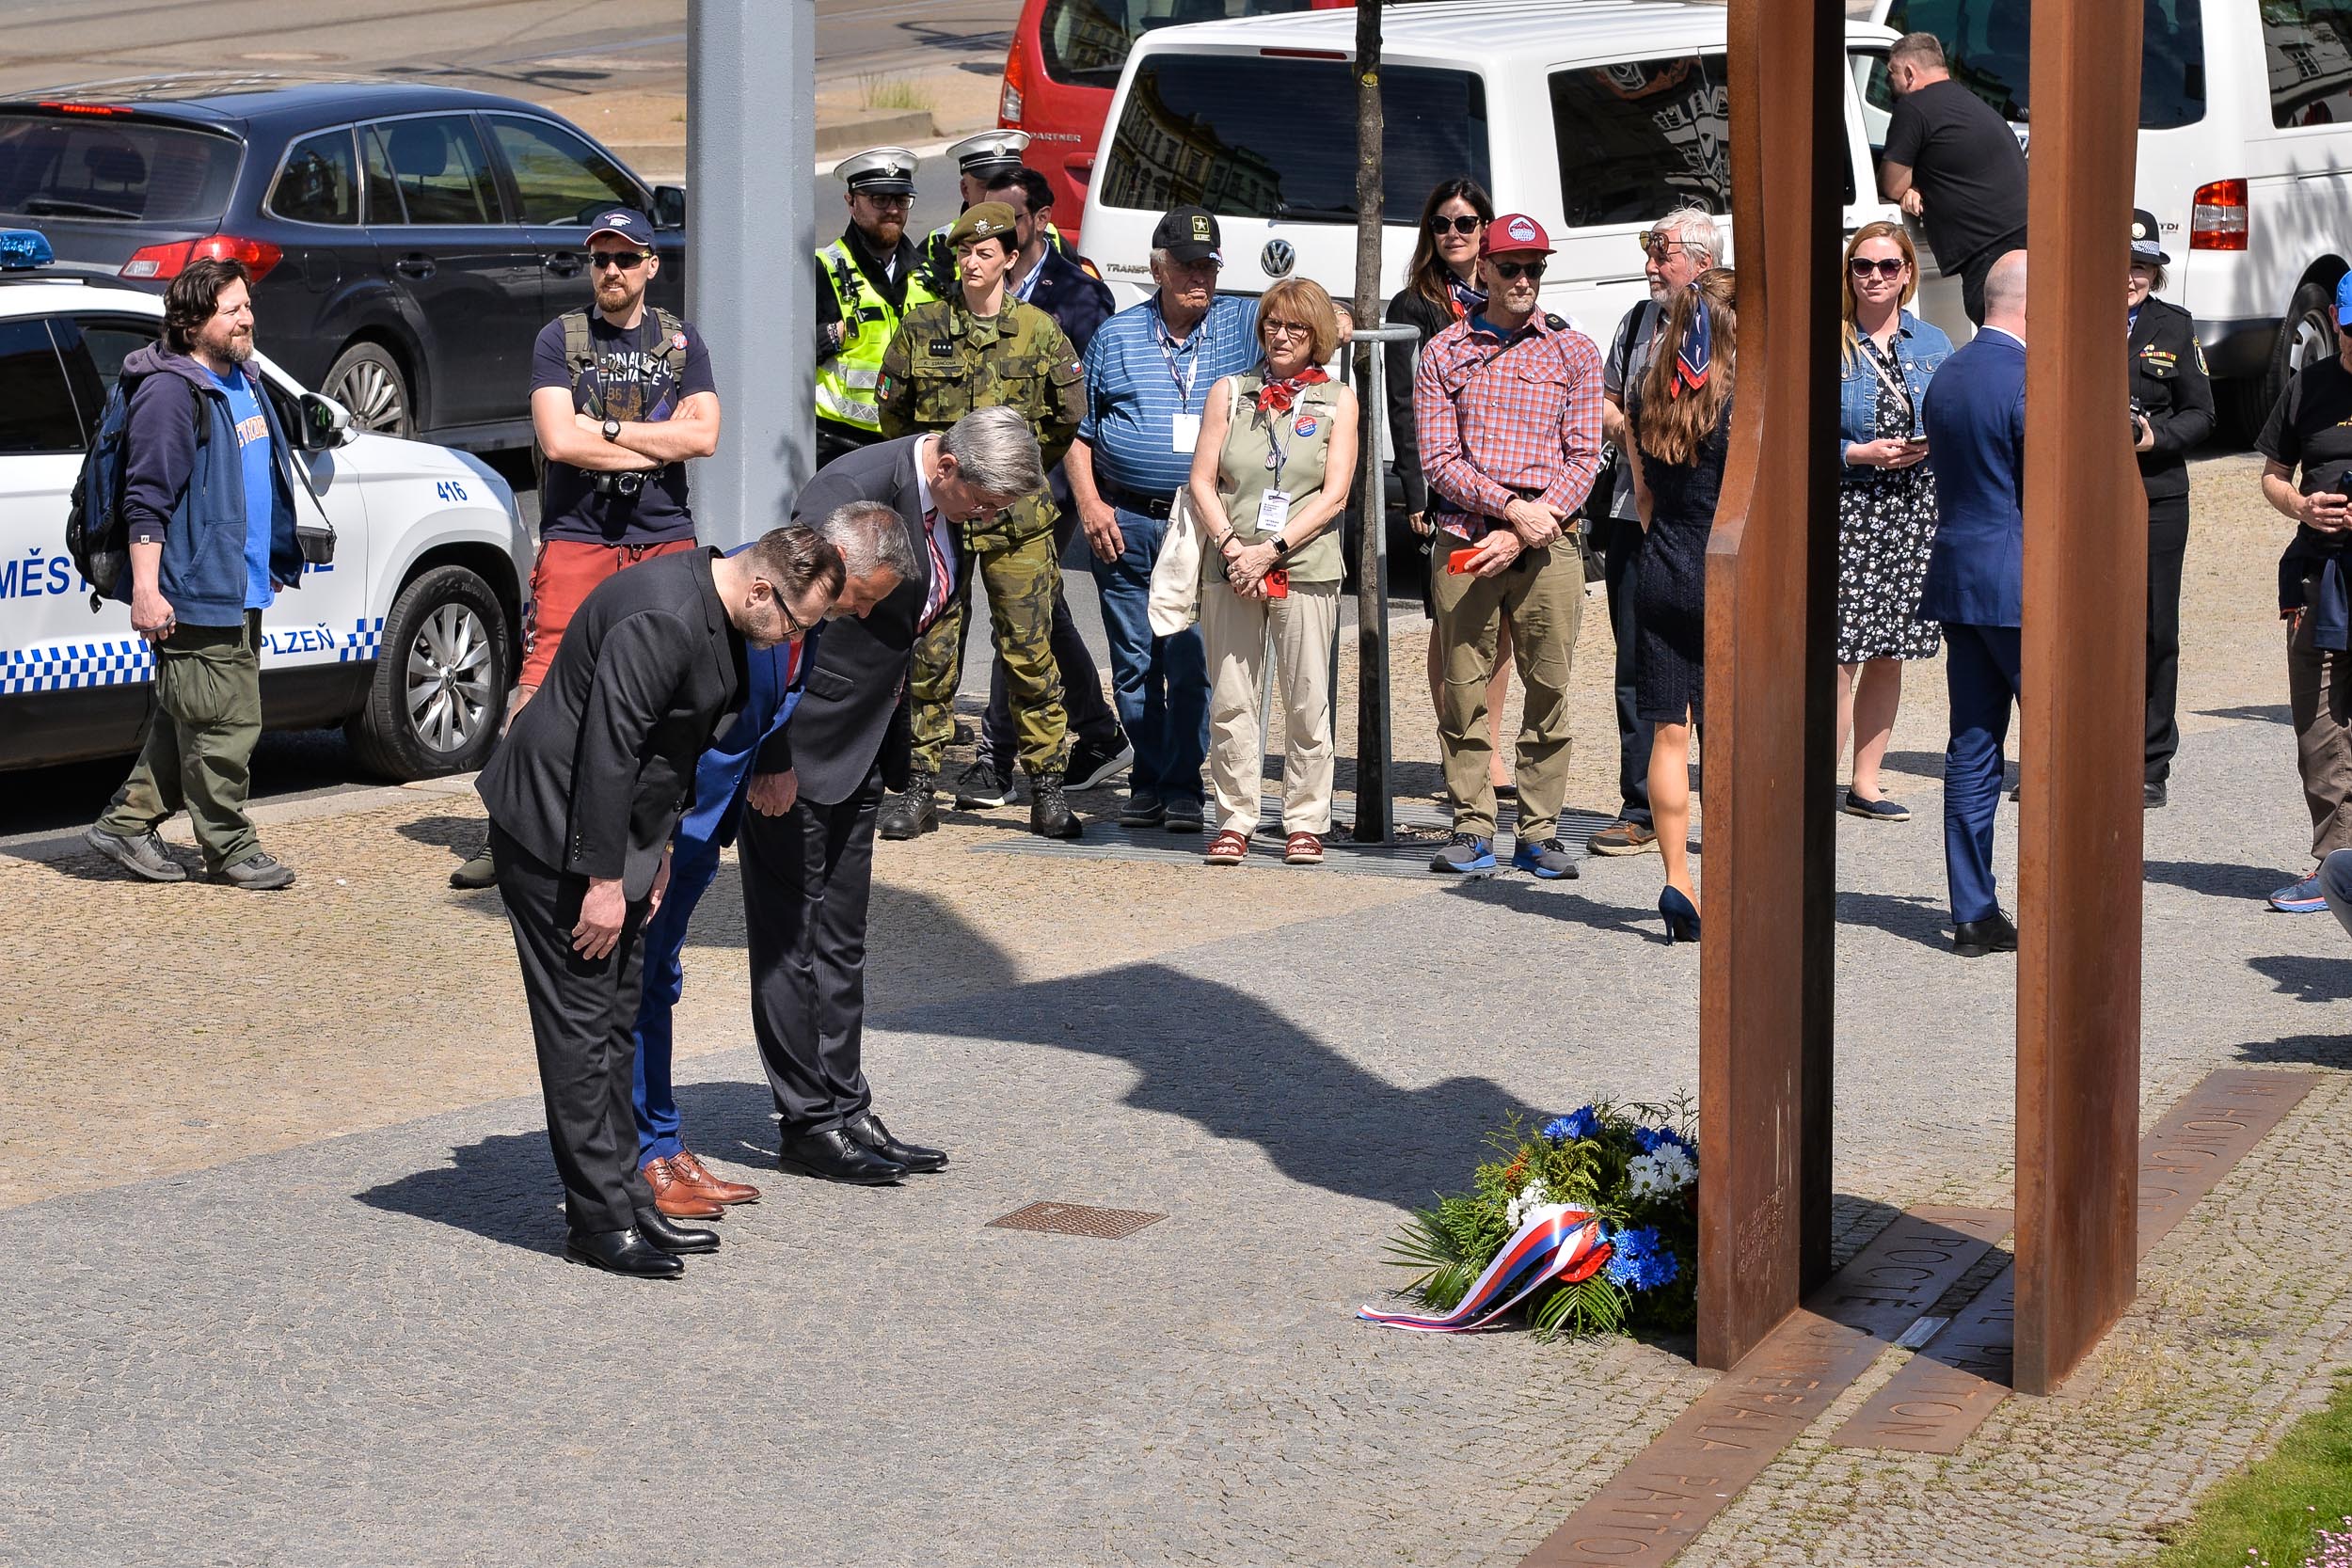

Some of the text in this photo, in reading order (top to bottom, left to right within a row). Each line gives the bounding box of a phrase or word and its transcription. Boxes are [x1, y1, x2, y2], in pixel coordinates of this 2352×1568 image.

[1030, 132, 1081, 143] PARTNER
[437, 481, 469, 502] 416
[0, 547, 87, 600] MĚS
[1835, 1235, 1970, 1308] POCTĚ
[1691, 1323, 1875, 1451] GENERÁLA
[1872, 1342, 2014, 1437] PATTON
